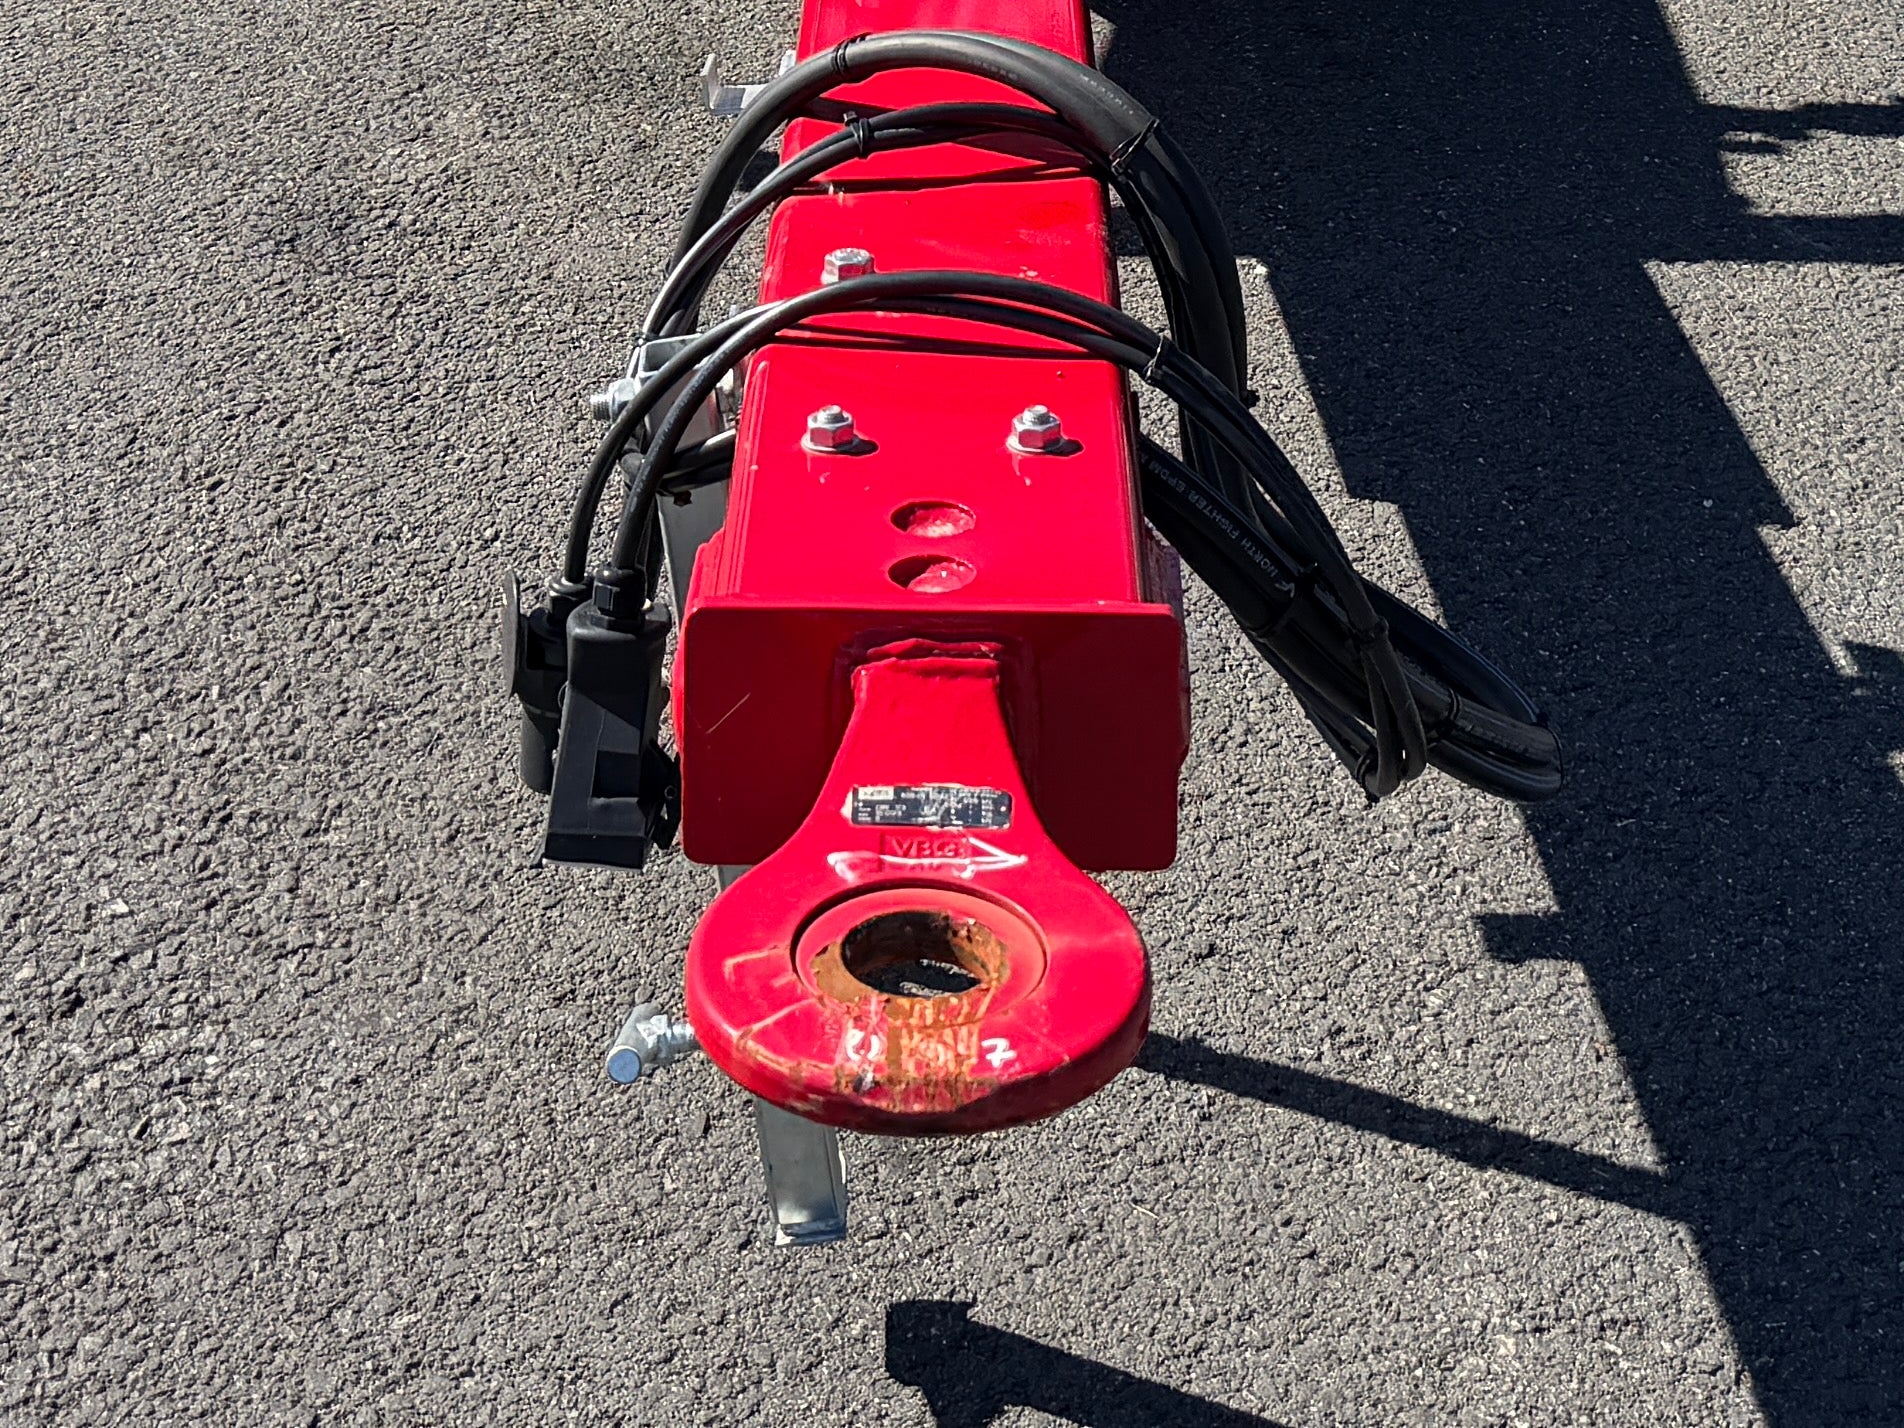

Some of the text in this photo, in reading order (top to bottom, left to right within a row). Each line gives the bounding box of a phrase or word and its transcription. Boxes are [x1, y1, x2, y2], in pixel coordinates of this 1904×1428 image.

[1148, 460, 1187, 492] EPDM
[1188, 490, 1240, 539] FIGHTER
[1241, 538, 1279, 578] NORTH
